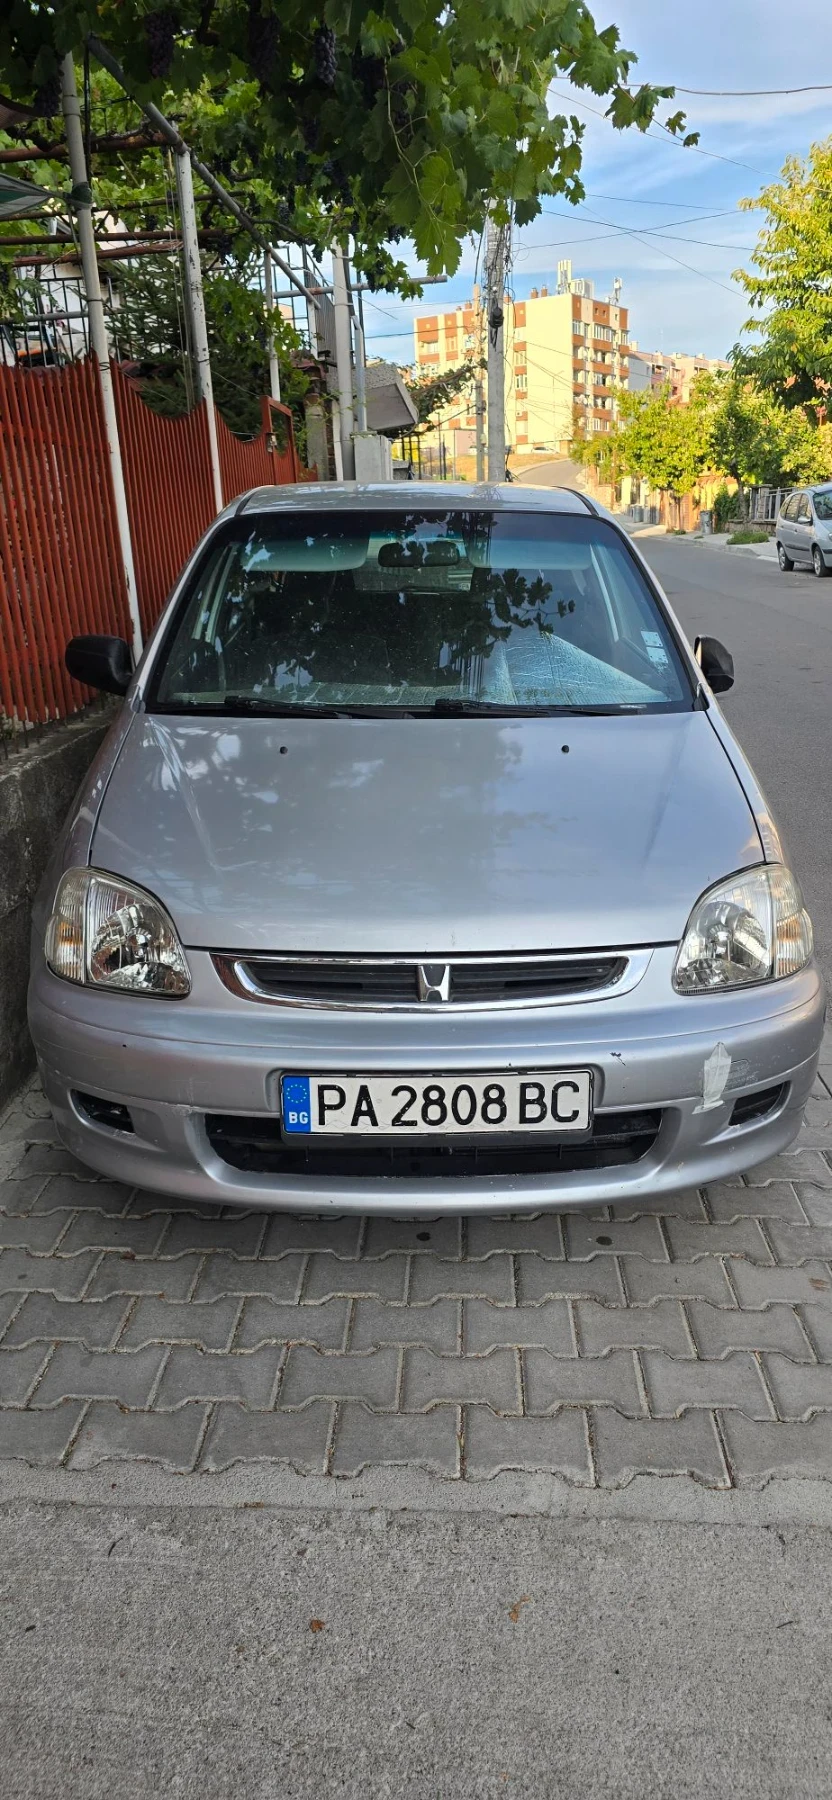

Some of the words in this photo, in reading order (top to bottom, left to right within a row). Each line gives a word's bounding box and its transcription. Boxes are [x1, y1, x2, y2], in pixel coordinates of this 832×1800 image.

[288, 1112, 309, 1124] BG
[317, 1084, 379, 1127] PA
[390, 1083, 508, 1127] 2808
[518, 1080, 580, 1125] BC
